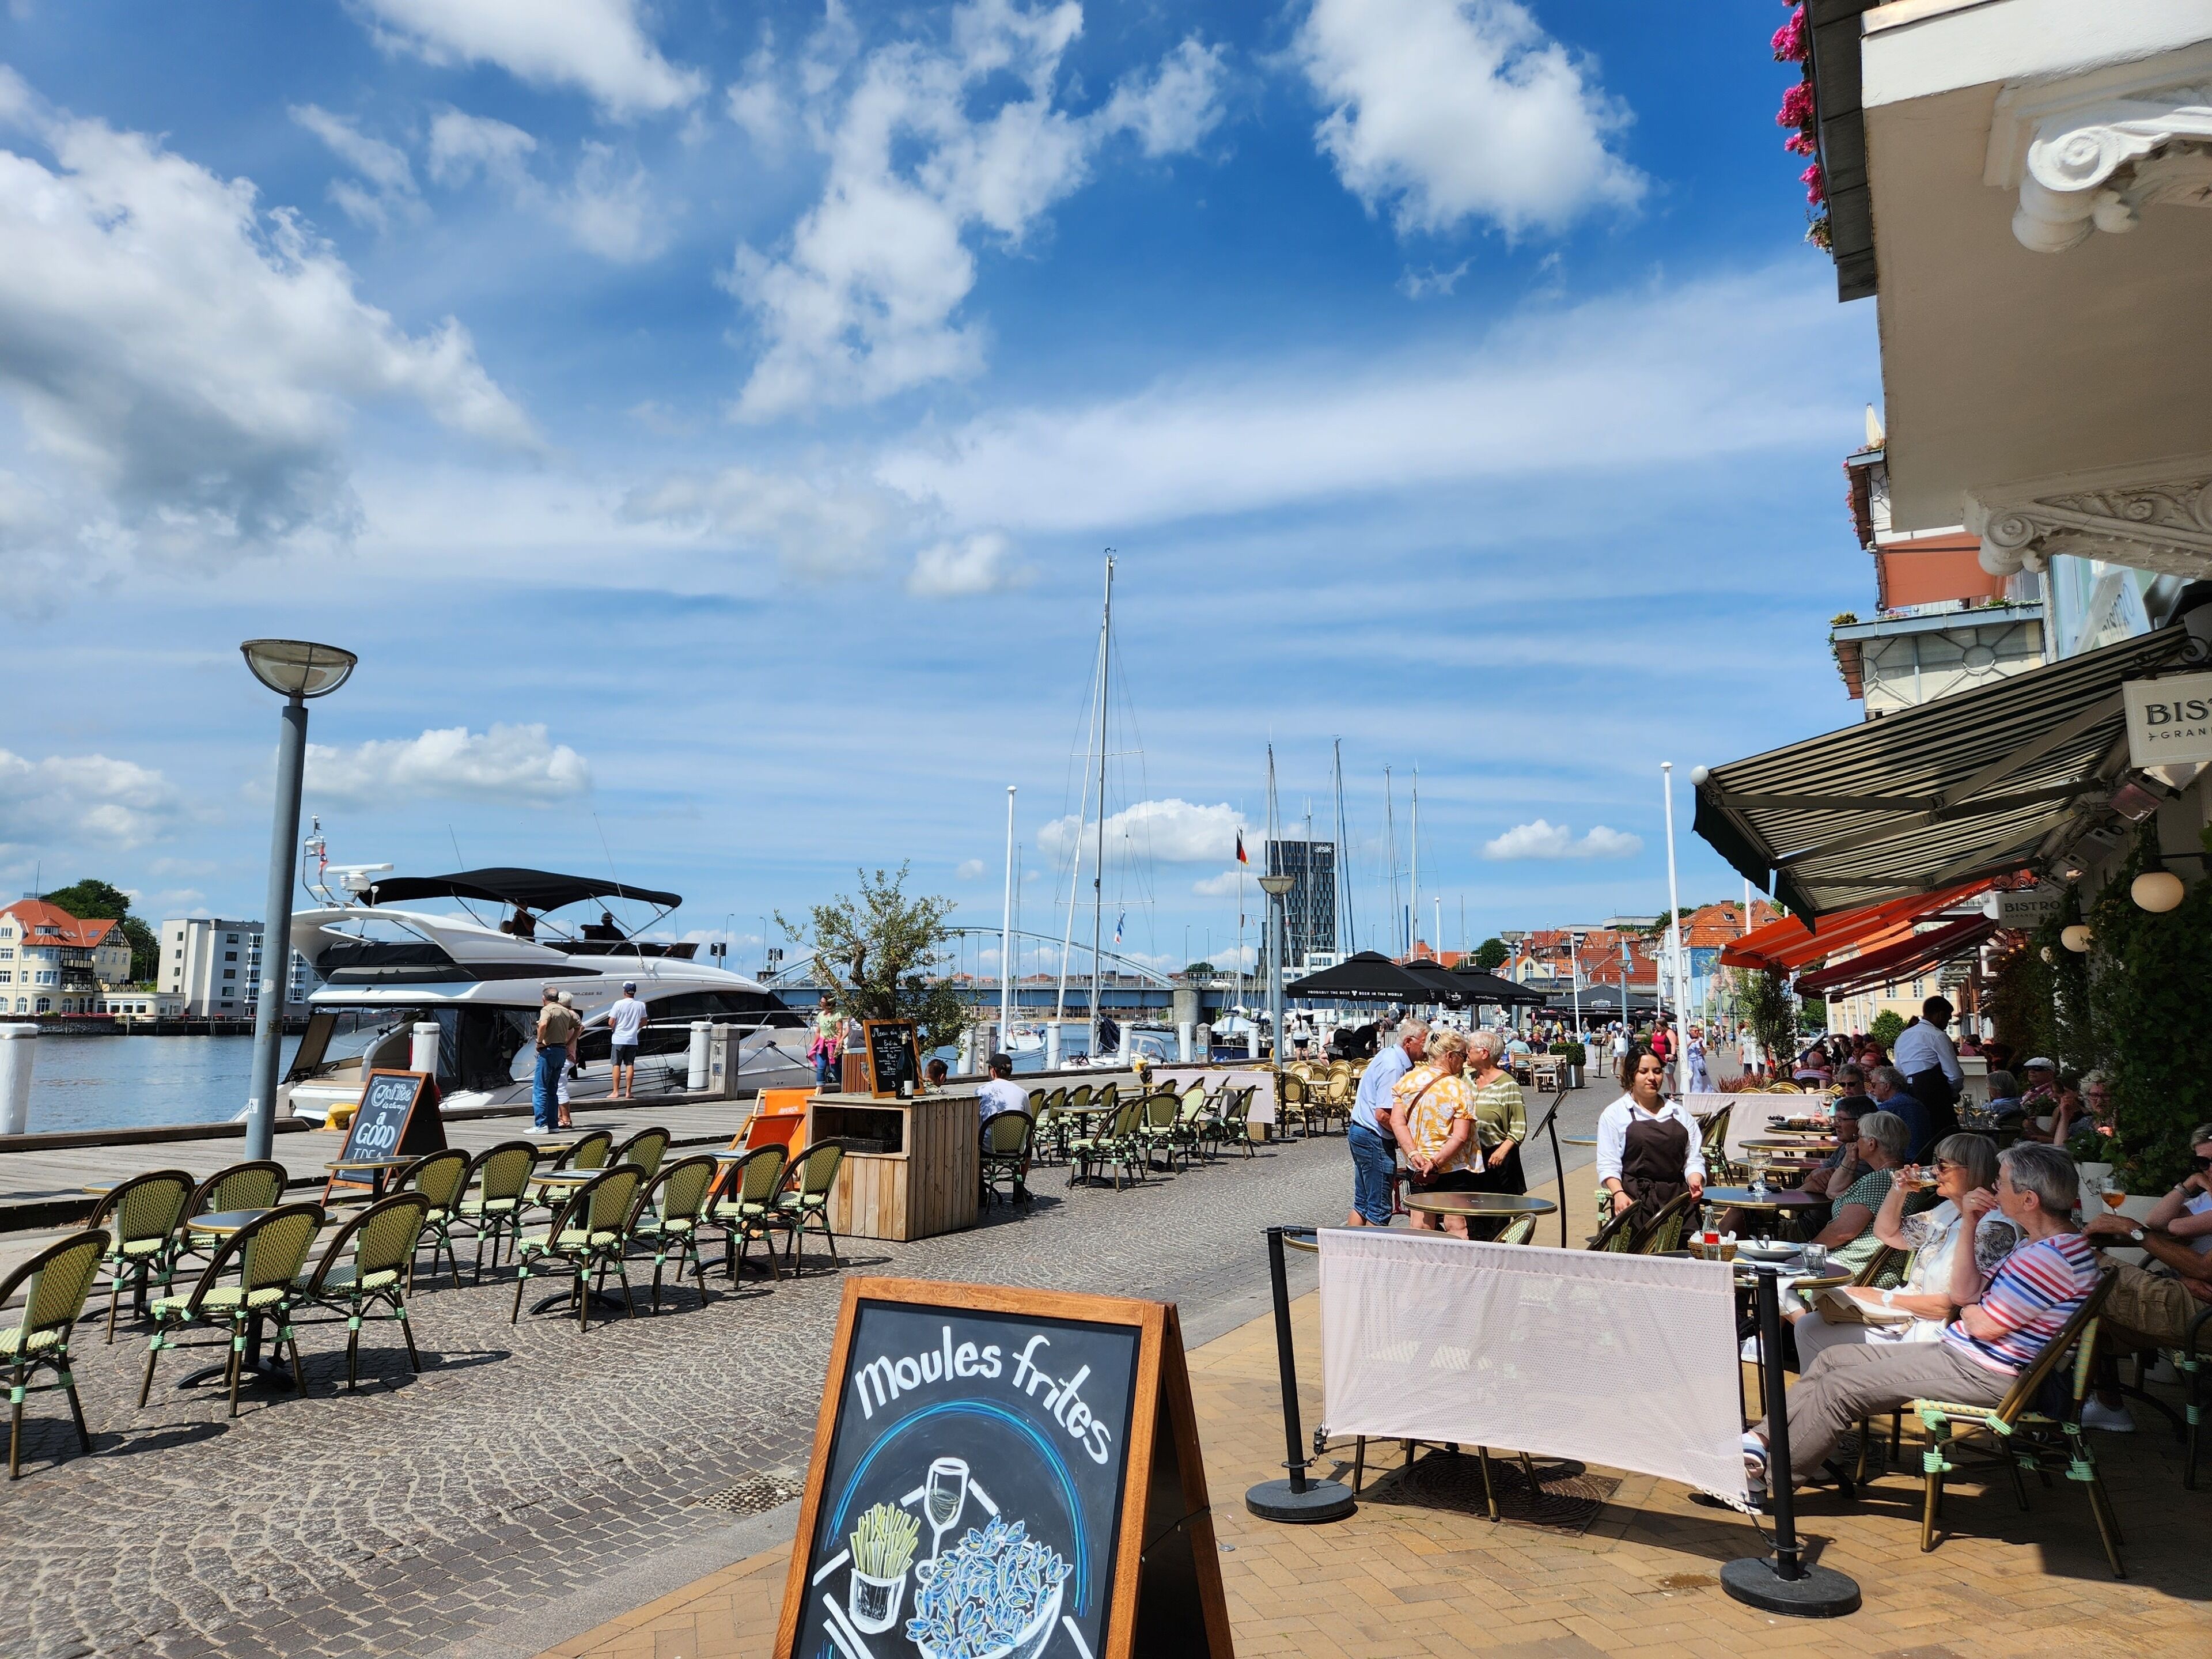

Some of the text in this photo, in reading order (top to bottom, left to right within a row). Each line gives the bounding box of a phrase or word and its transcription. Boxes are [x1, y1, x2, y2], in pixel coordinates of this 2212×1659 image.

[2145, 698, 2212, 725] BIS
[2161, 727, 2212, 739] GRAN
[2004, 900, 2061, 912] BISTRO
[372, 1082, 411, 1107] Coffee
[376, 1111, 387, 1126] a
[355, 1123, 396, 1149] GOOD
[1012, 1335, 1112, 1465] frites
